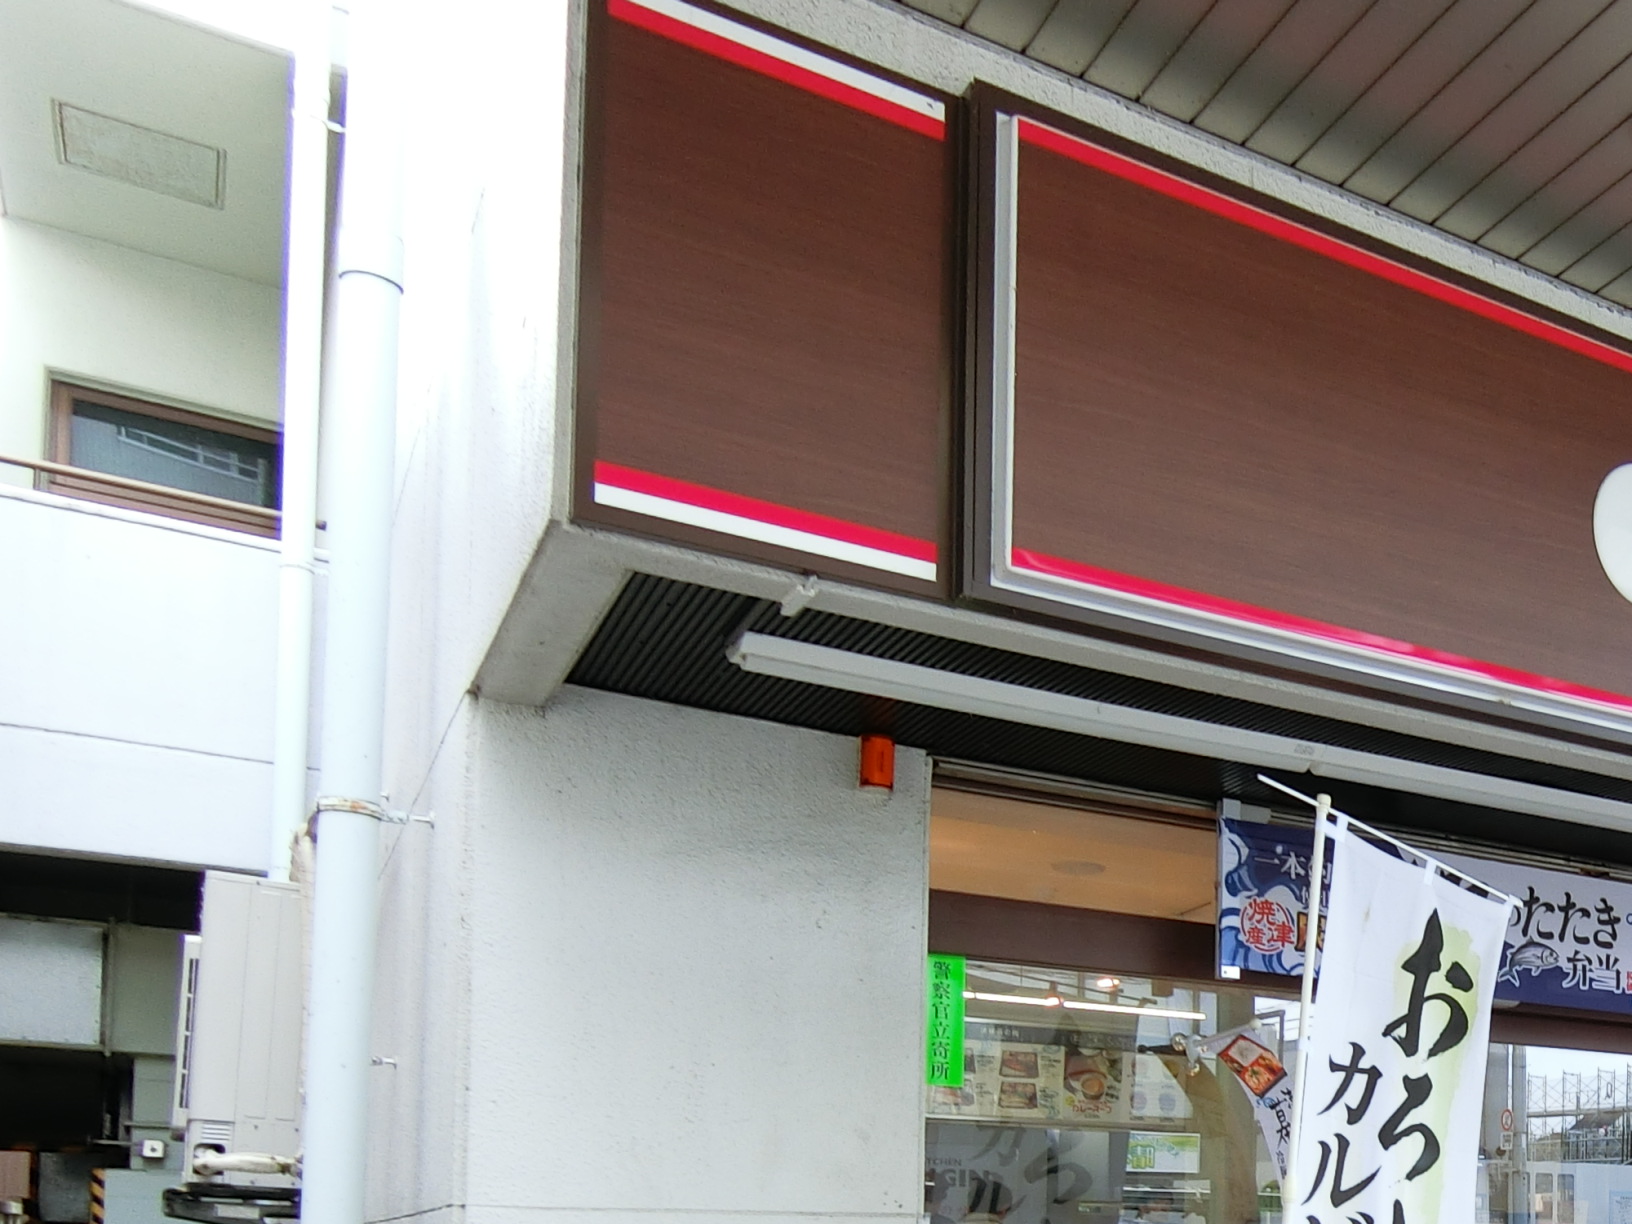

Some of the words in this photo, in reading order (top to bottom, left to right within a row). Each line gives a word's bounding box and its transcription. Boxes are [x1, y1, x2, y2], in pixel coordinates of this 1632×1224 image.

[1562, 949, 1622, 992] 弁当
[930, 961, 951, 1080] 警察官立寄所
